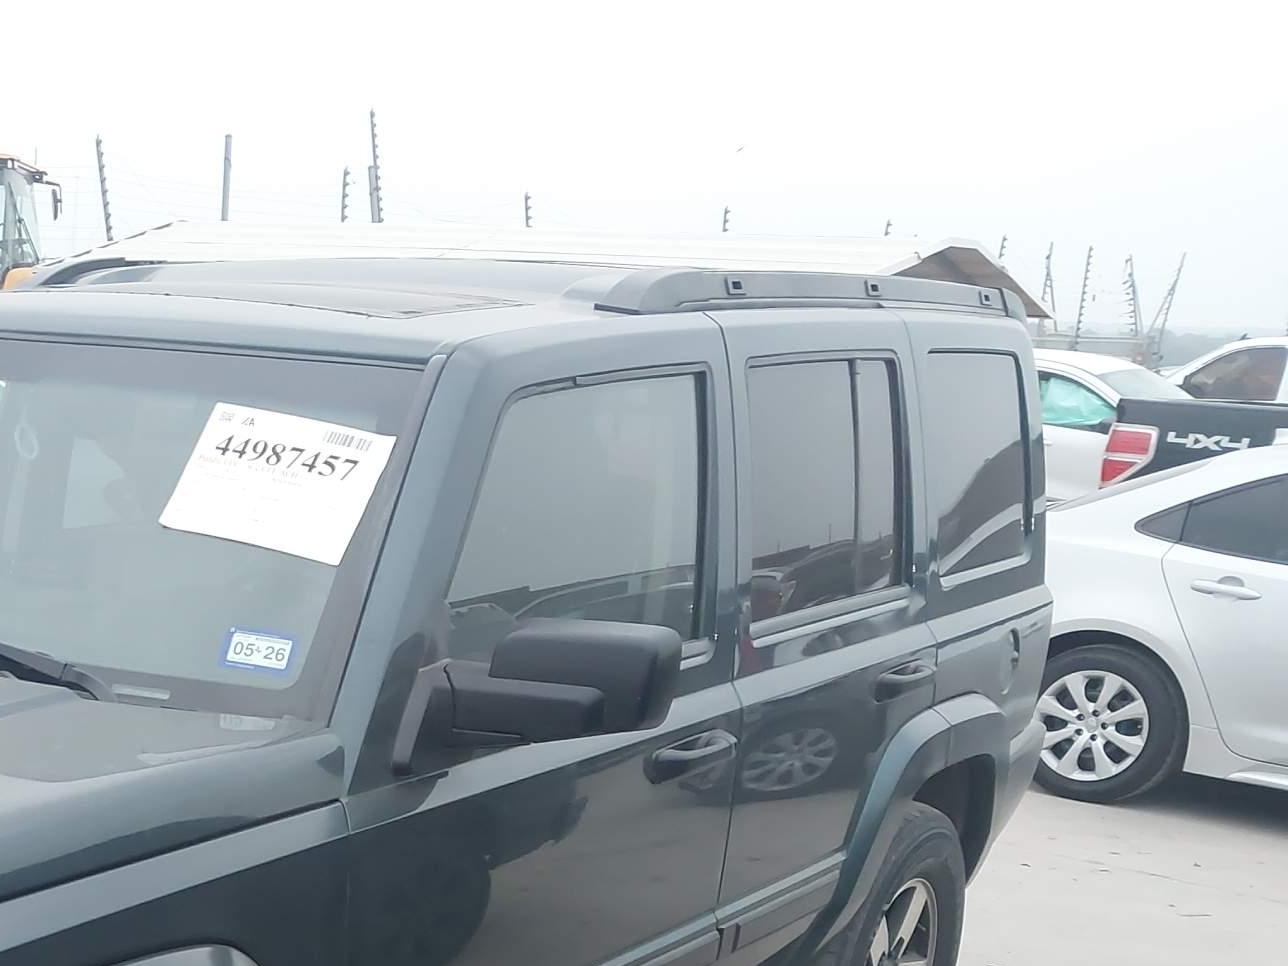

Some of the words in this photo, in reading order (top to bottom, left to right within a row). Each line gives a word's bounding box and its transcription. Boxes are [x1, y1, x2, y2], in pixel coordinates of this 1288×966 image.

[215, 434, 360, 481] 44987457
[233, 641, 255, 657] 05
[263, 645, 286, 662] 26
